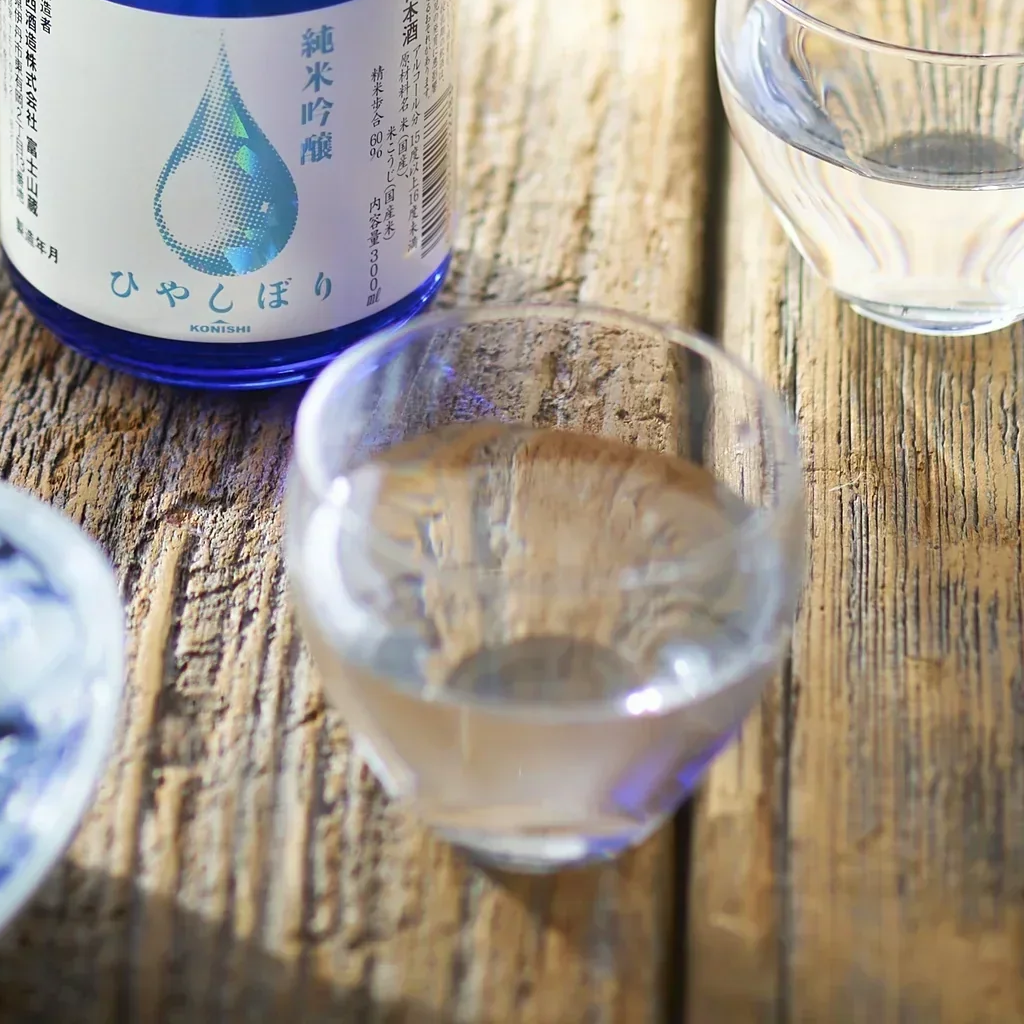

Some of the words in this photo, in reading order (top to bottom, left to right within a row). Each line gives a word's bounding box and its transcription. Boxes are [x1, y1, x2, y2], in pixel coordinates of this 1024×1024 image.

[300, 24, 335, 166] 純米吟醸
[370, 65, 385, 127] 精米歩合
[399, 50, 410, 113] 原材料名
[411, 44, 422, 127] アルコール分
[110, 270, 332, 314] ひやしぼり
[189, 324, 252, 334] KONISHI
